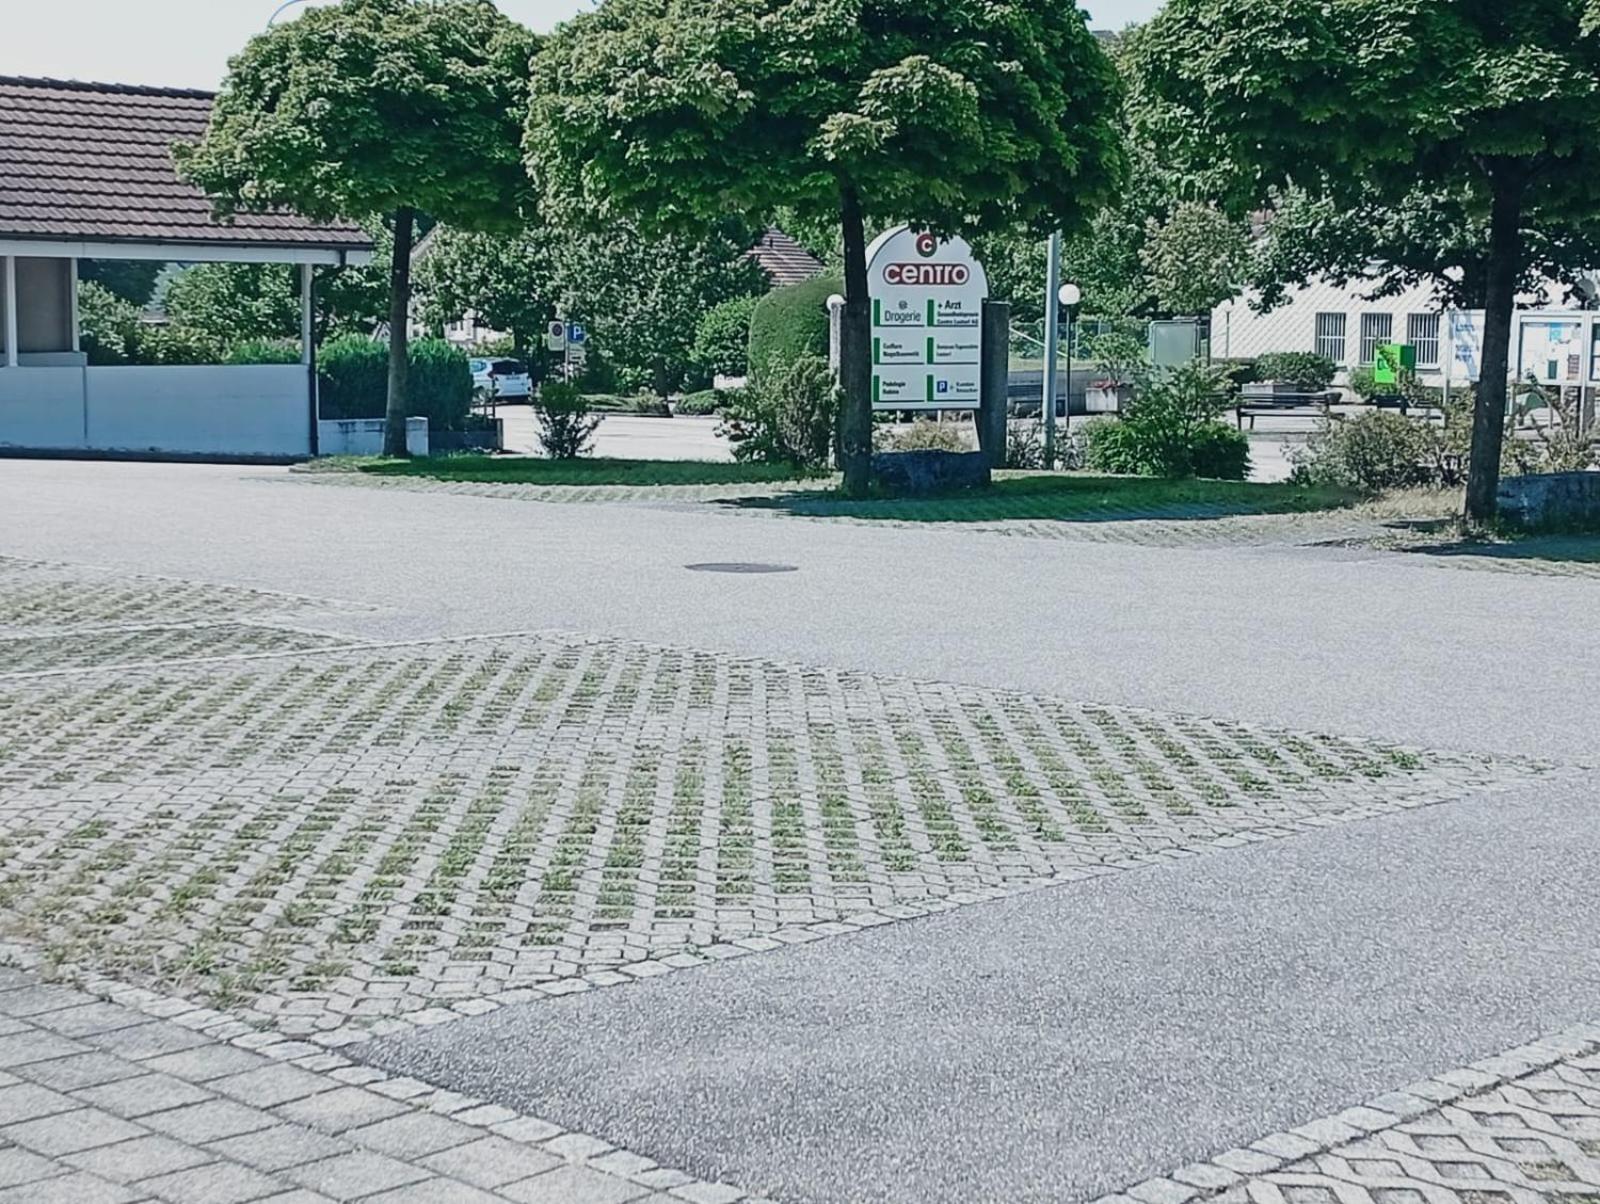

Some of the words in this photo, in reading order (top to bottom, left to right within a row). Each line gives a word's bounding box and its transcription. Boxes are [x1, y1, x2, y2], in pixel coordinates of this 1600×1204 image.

[884, 264, 968, 284] centro
[944, 299, 962, 309] Arzt
[884, 310, 922, 324] Drogerie
